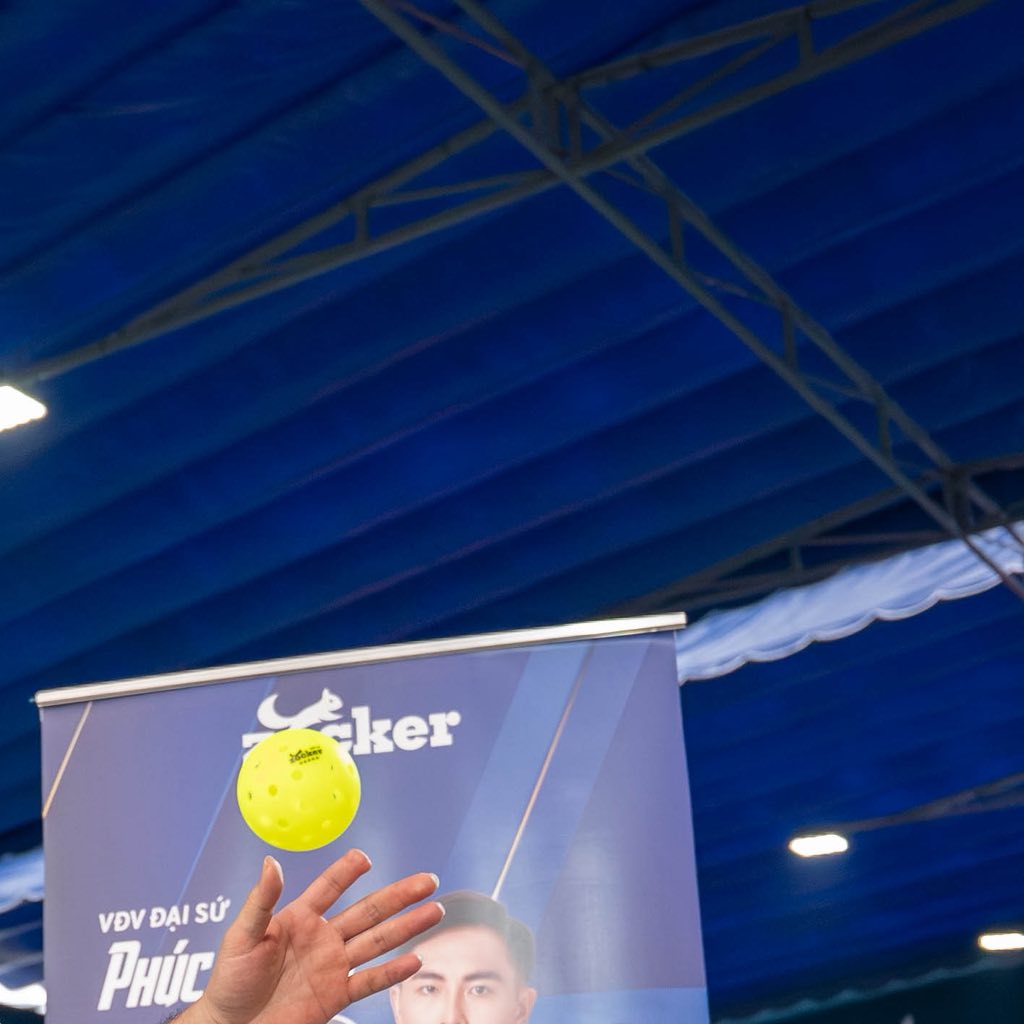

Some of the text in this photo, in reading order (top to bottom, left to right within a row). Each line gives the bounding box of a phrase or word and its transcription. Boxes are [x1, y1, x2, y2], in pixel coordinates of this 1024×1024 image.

[242, 706, 461, 759] cker
[98, 908, 146, 934] VĐV
[149, 904, 190, 933] ĐẠI
